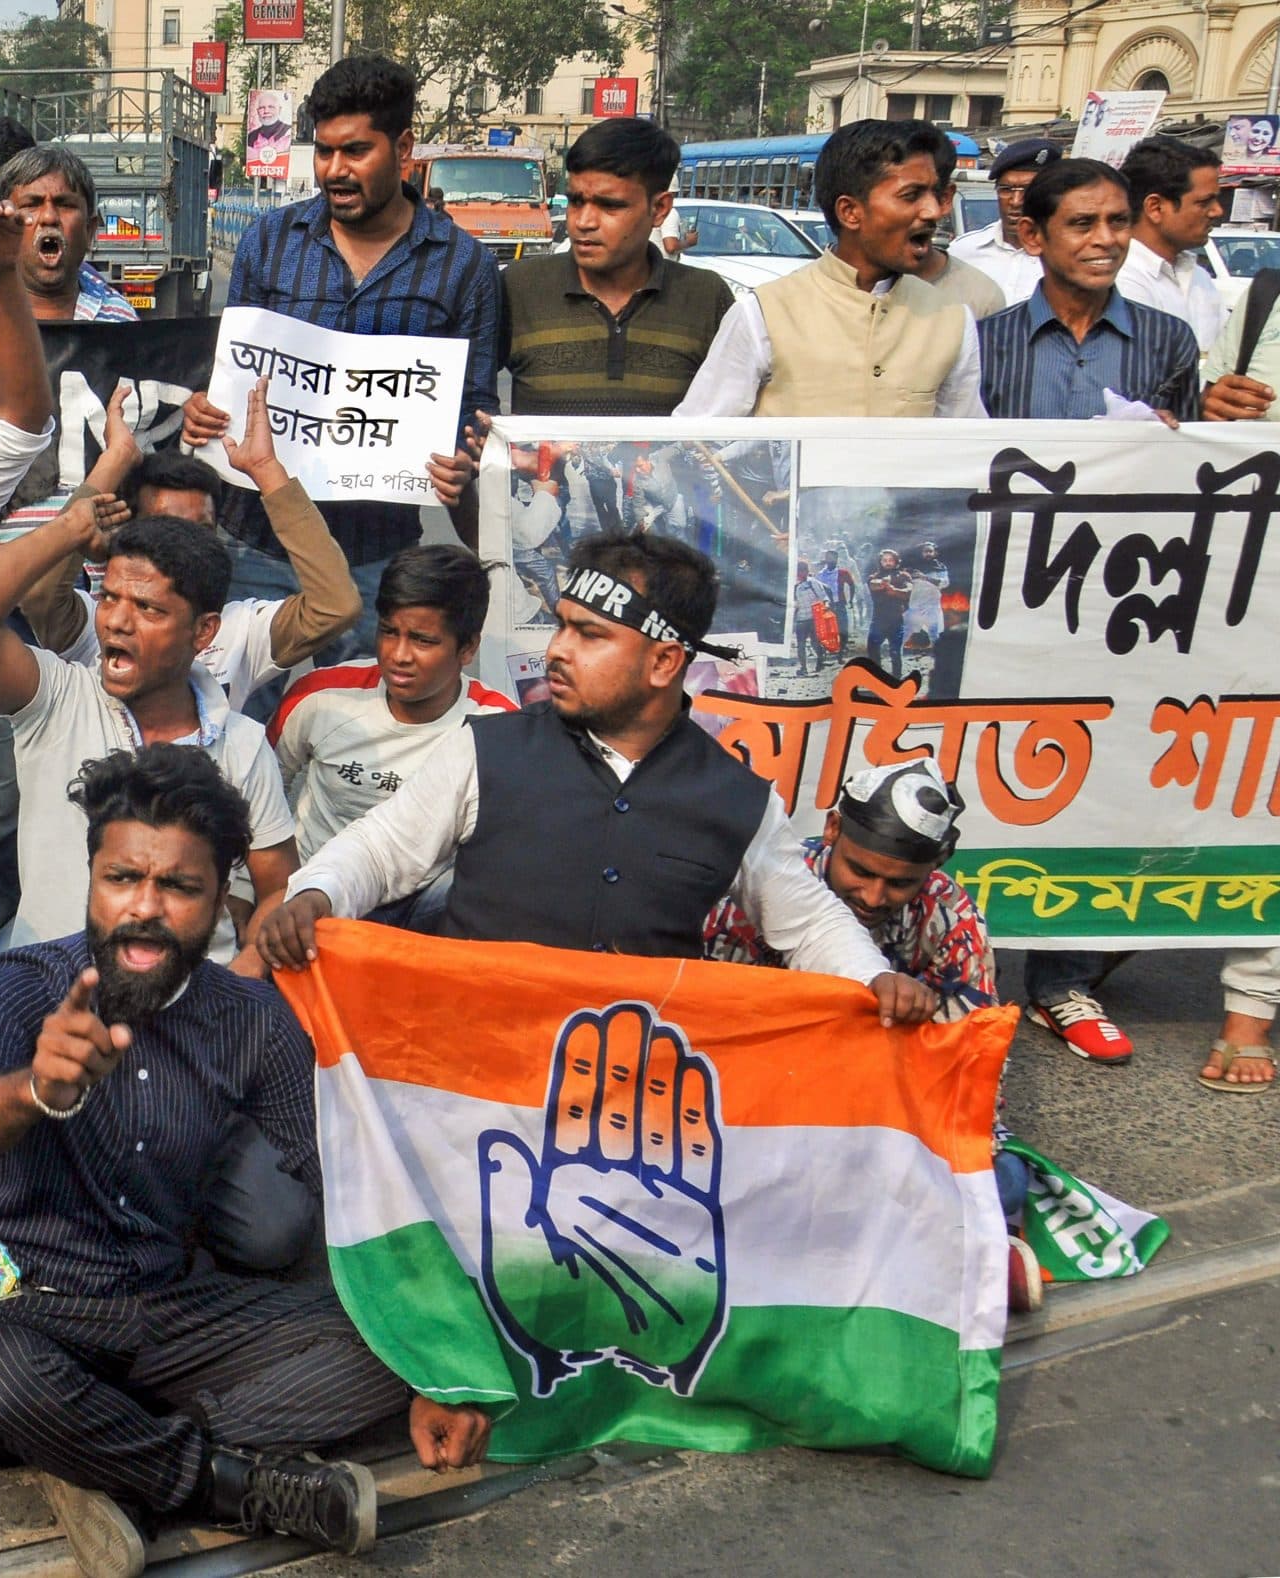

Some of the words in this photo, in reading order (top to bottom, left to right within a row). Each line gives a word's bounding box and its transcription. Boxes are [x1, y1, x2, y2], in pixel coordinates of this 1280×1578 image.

[253, 4, 297, 20] CEMENT
[195, 59, 221, 73] STAR
[602, 89, 627, 103] STAR
[230, 340, 336, 396] আমরা
[345, 358, 442, 401] সবাই
[266, 404, 399, 448] ভারতীয়
[570, 568, 632, 618] NPR
[1149, 693, 1280, 818] শা
[955, 858, 1280, 922] শ্চিমবঙ্গ
